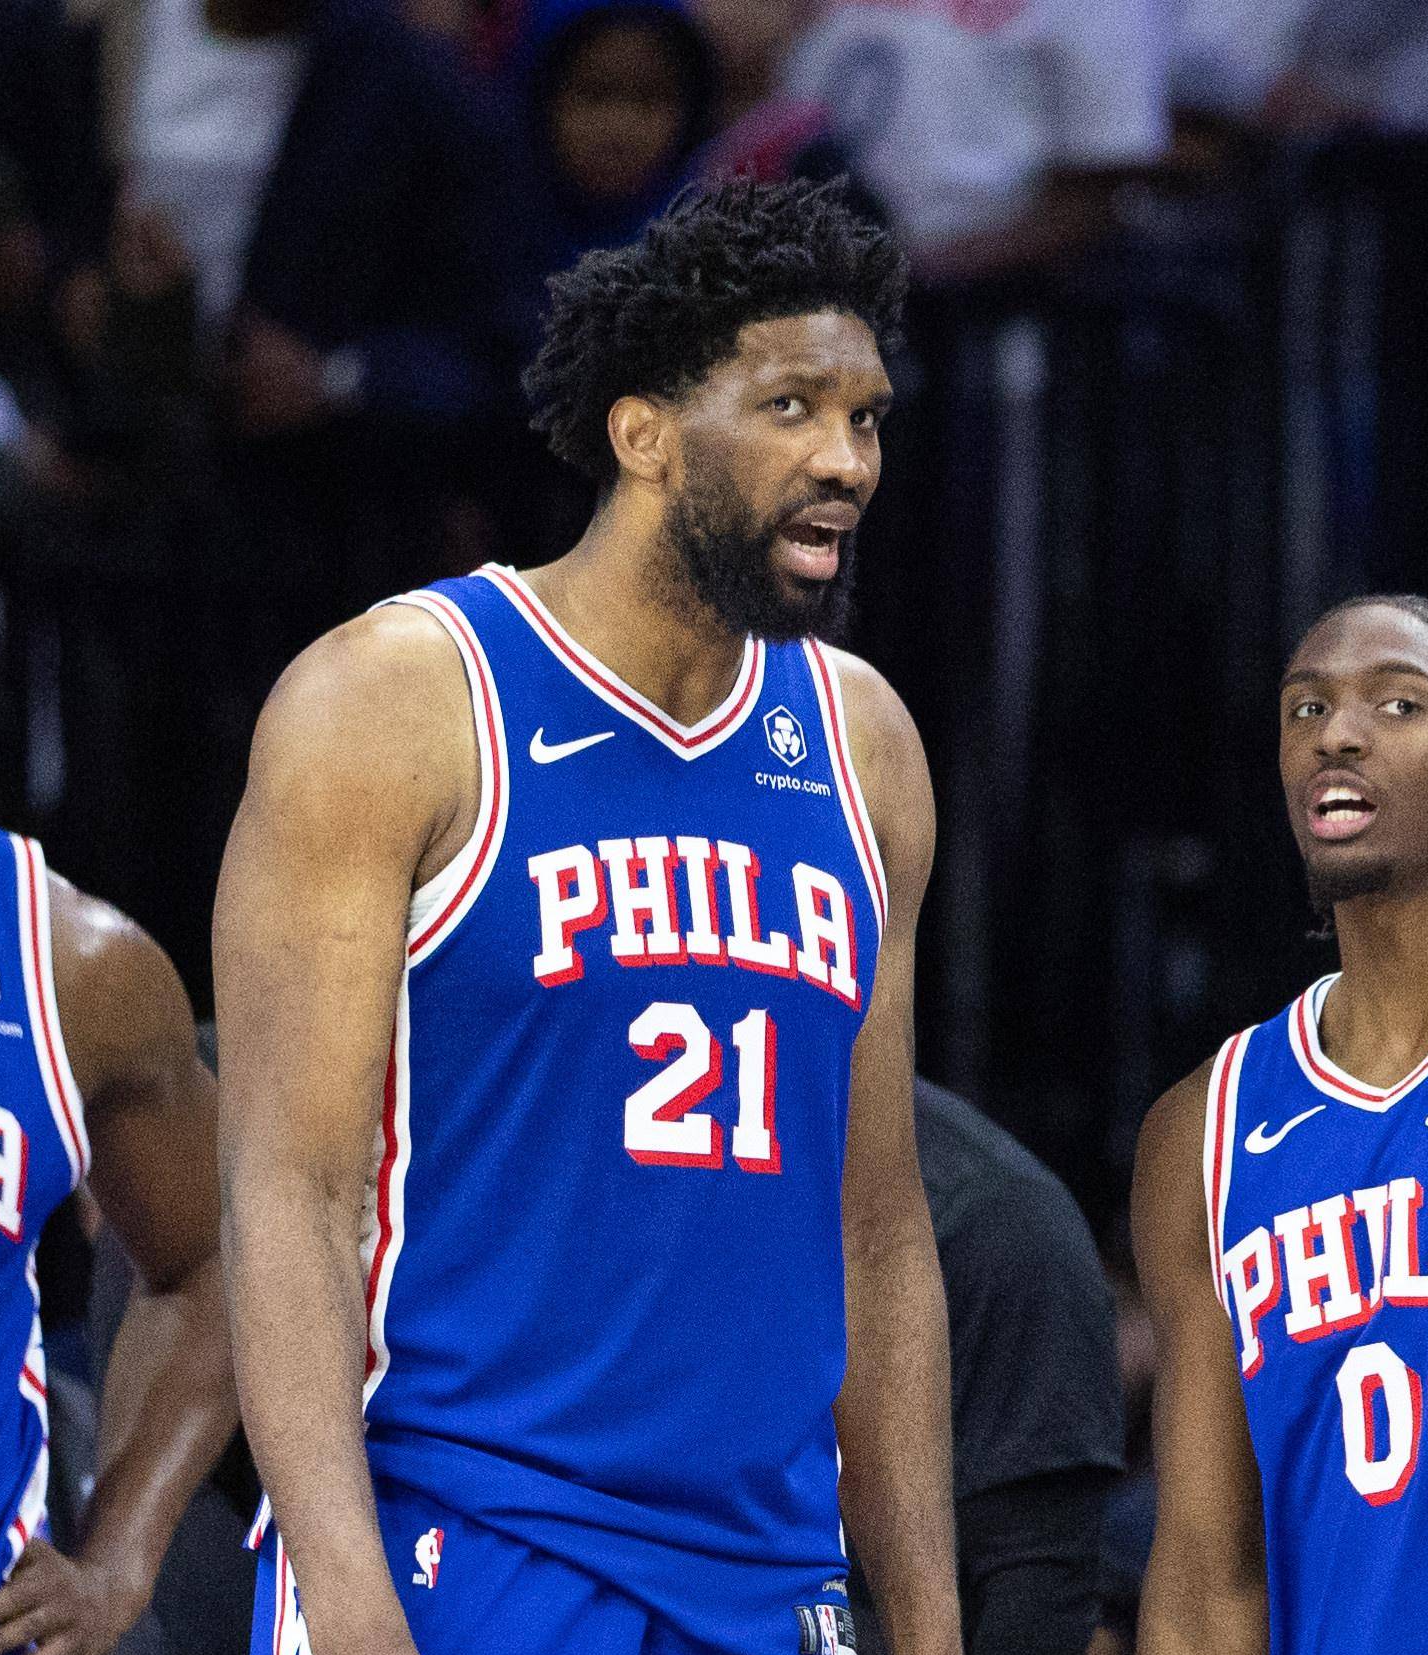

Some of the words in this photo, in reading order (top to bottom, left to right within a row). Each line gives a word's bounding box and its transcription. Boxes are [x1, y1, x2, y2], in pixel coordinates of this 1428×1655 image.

[755, 772, 831, 797] crypto.com
[528, 835, 862, 1012] PHILA
[624, 1001, 782, 1174] 21
[1336, 1342, 1422, 1507] 0
